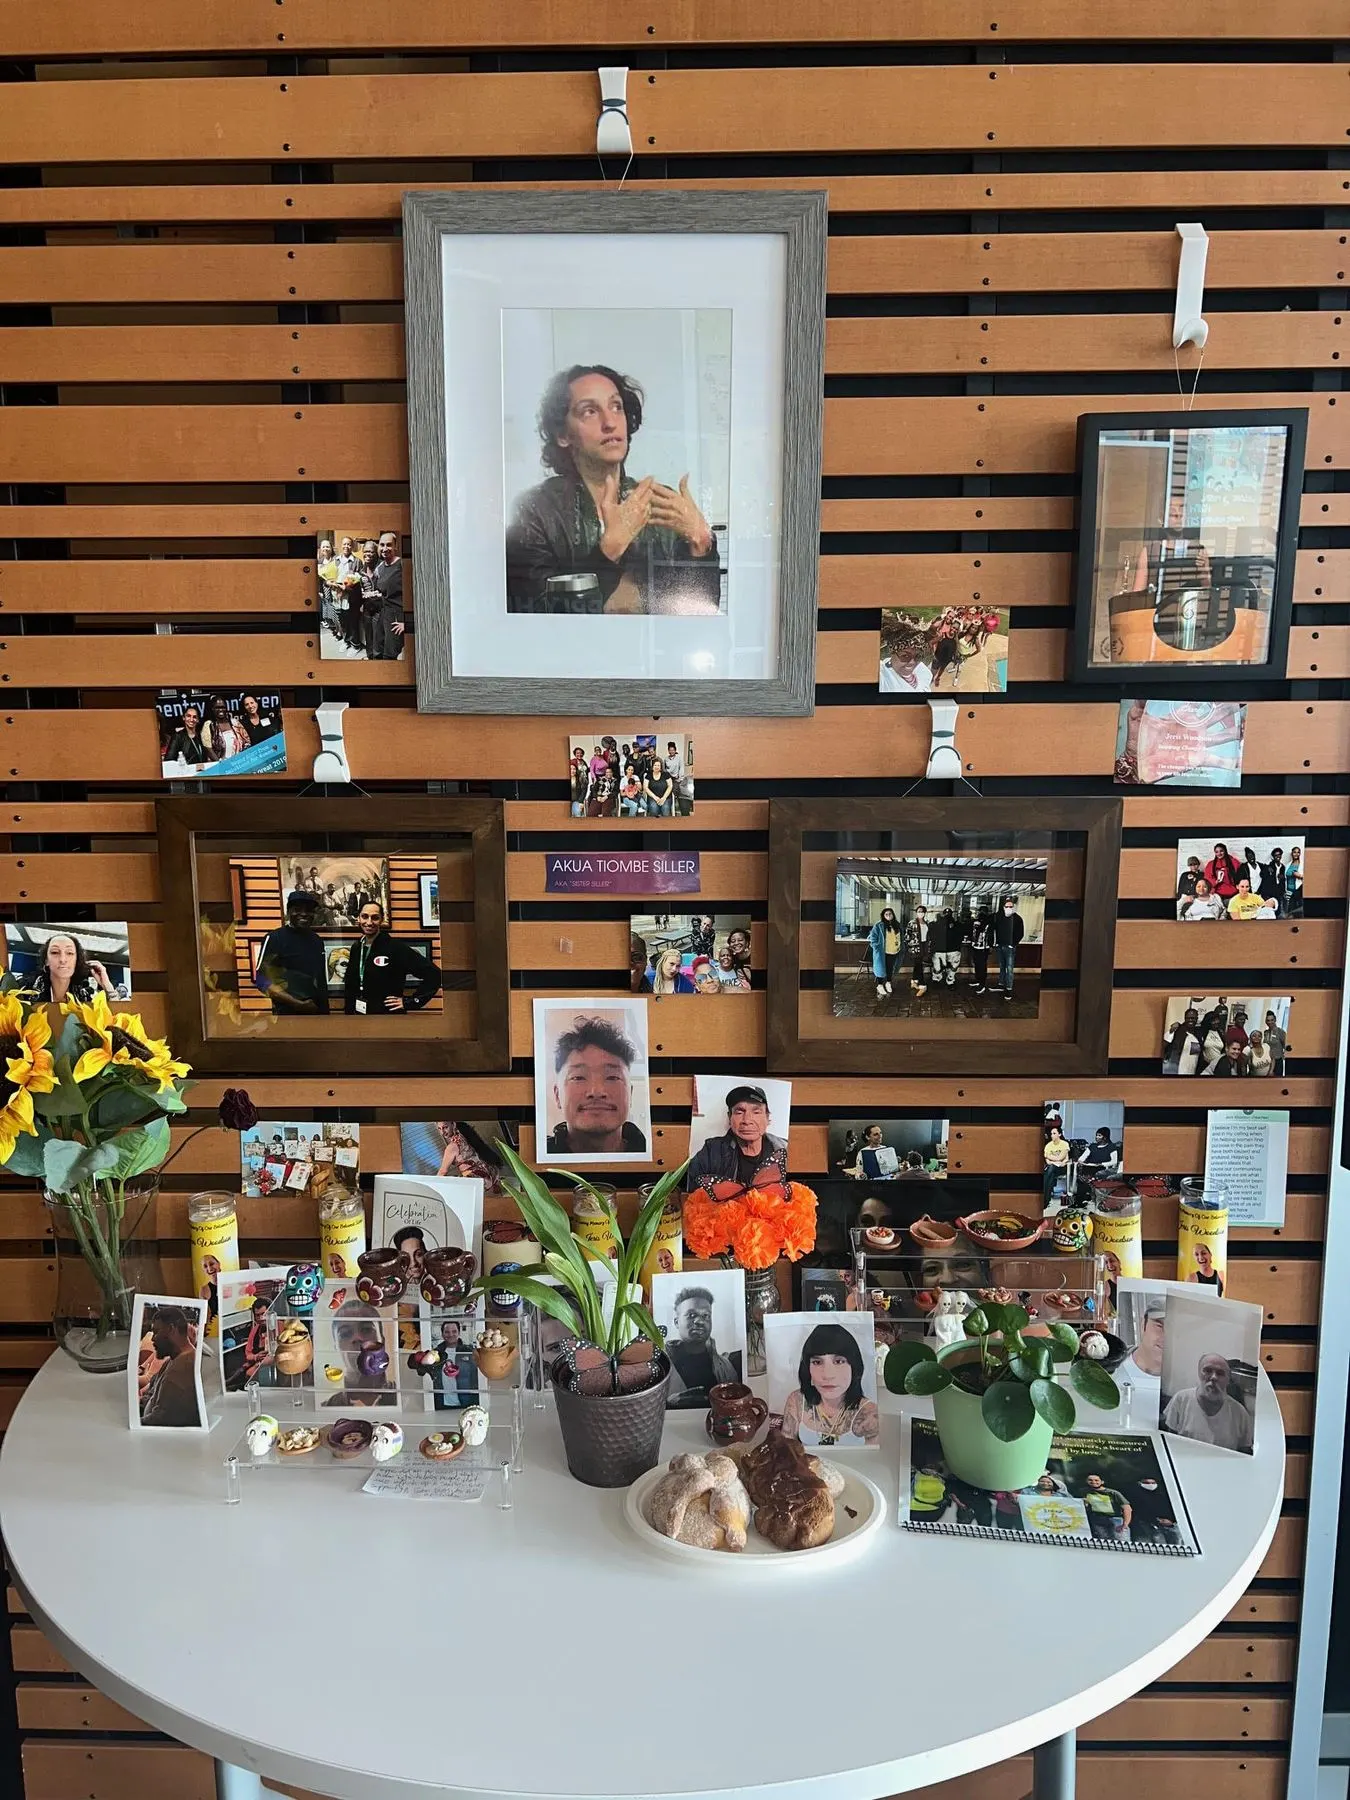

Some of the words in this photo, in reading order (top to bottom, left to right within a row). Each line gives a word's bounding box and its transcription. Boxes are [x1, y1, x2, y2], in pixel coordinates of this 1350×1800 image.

[552, 860, 592, 872] AKUA
[596, 860, 650, 872] TIOMBE
[652, 860, 695, 873] SILLER
[386, 1204, 438, 1221] Celebration
